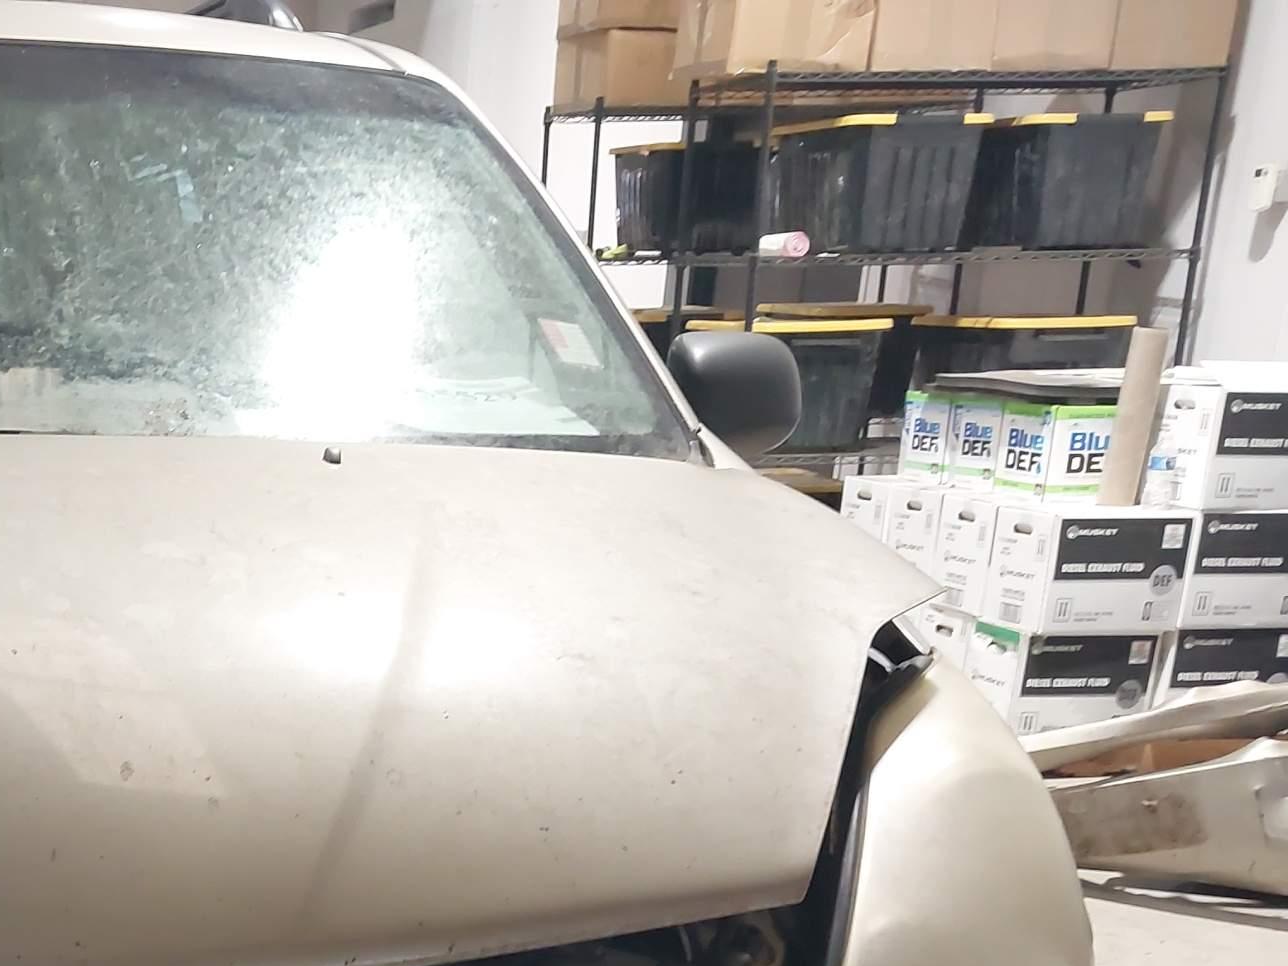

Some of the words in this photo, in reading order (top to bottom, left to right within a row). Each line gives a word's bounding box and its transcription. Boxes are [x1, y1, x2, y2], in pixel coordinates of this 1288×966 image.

[914, 418, 940, 434] Blue
[964, 422, 992, 439] Blue
[1008, 428, 1043, 451] Blue
[1069, 432, 1110, 451] Blu
[1005, 449, 1042, 472] DEF
[1065, 453, 1105, 473] DE
[1153, 575, 1174, 588] DEF
